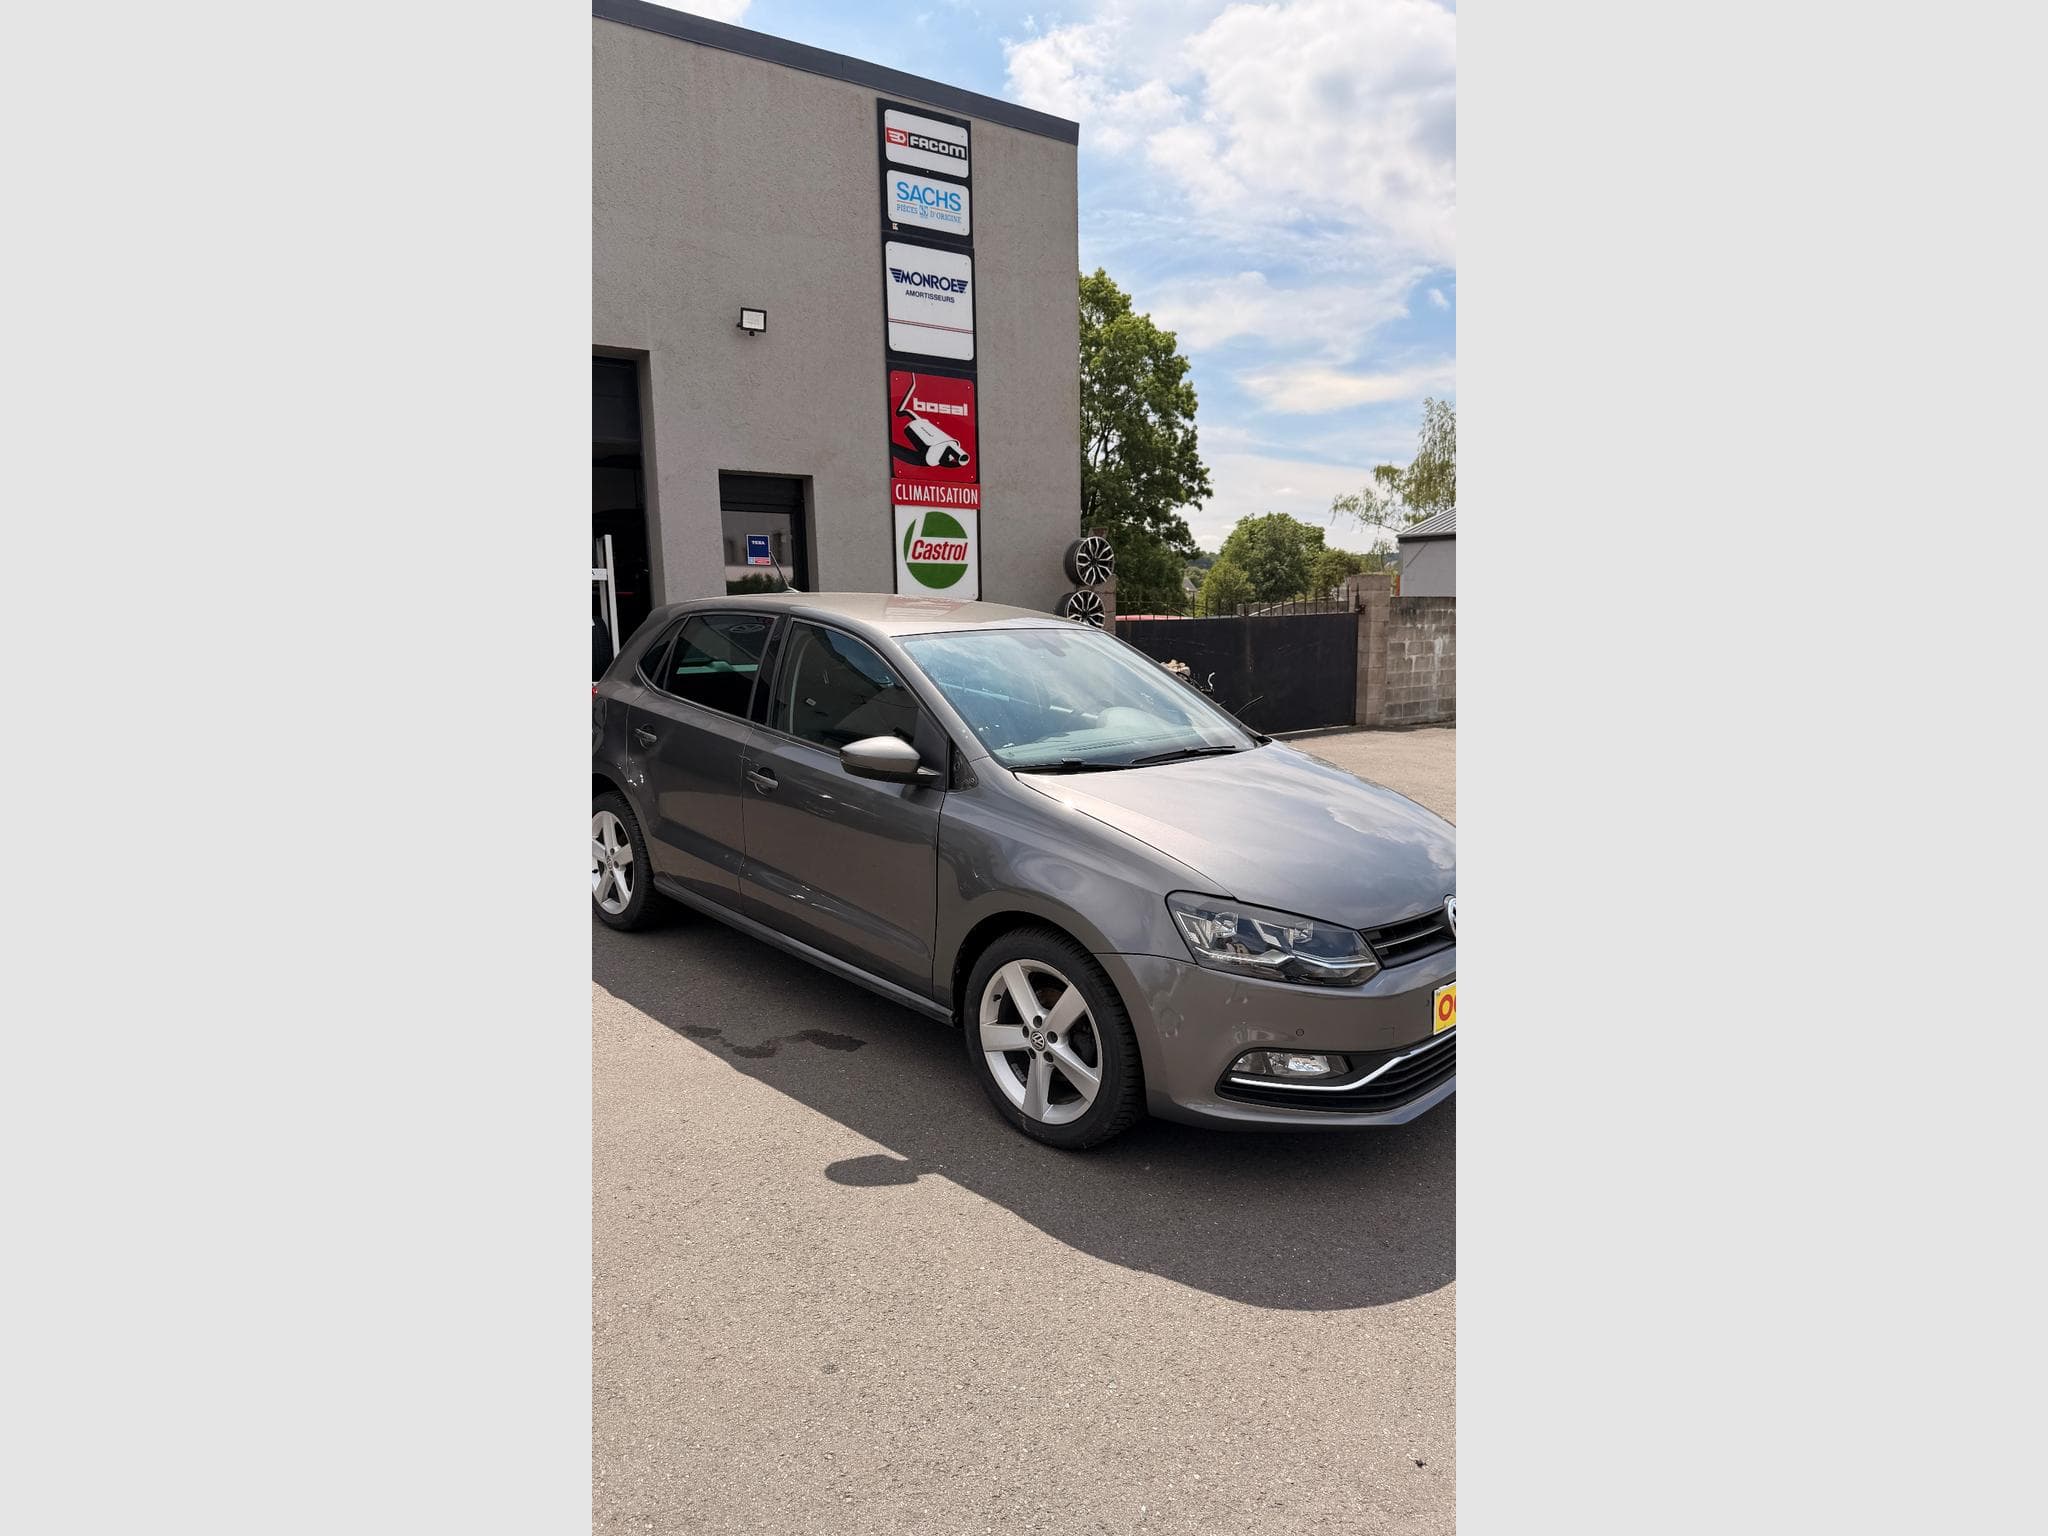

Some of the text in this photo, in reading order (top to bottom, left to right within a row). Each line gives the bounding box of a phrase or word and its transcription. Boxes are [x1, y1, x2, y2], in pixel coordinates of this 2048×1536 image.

[909, 135, 966, 159] FACOM
[896, 181, 962, 212] SACHS
[900, 270, 959, 293] MONROE
[905, 289, 955, 304] AMORTISSEURS
[912, 397, 969, 416] bosal
[895, 483, 978, 505] CLIMATISATION
[911, 539, 969, 561] Castrol
[1439, 992, 1456, 1021] O
